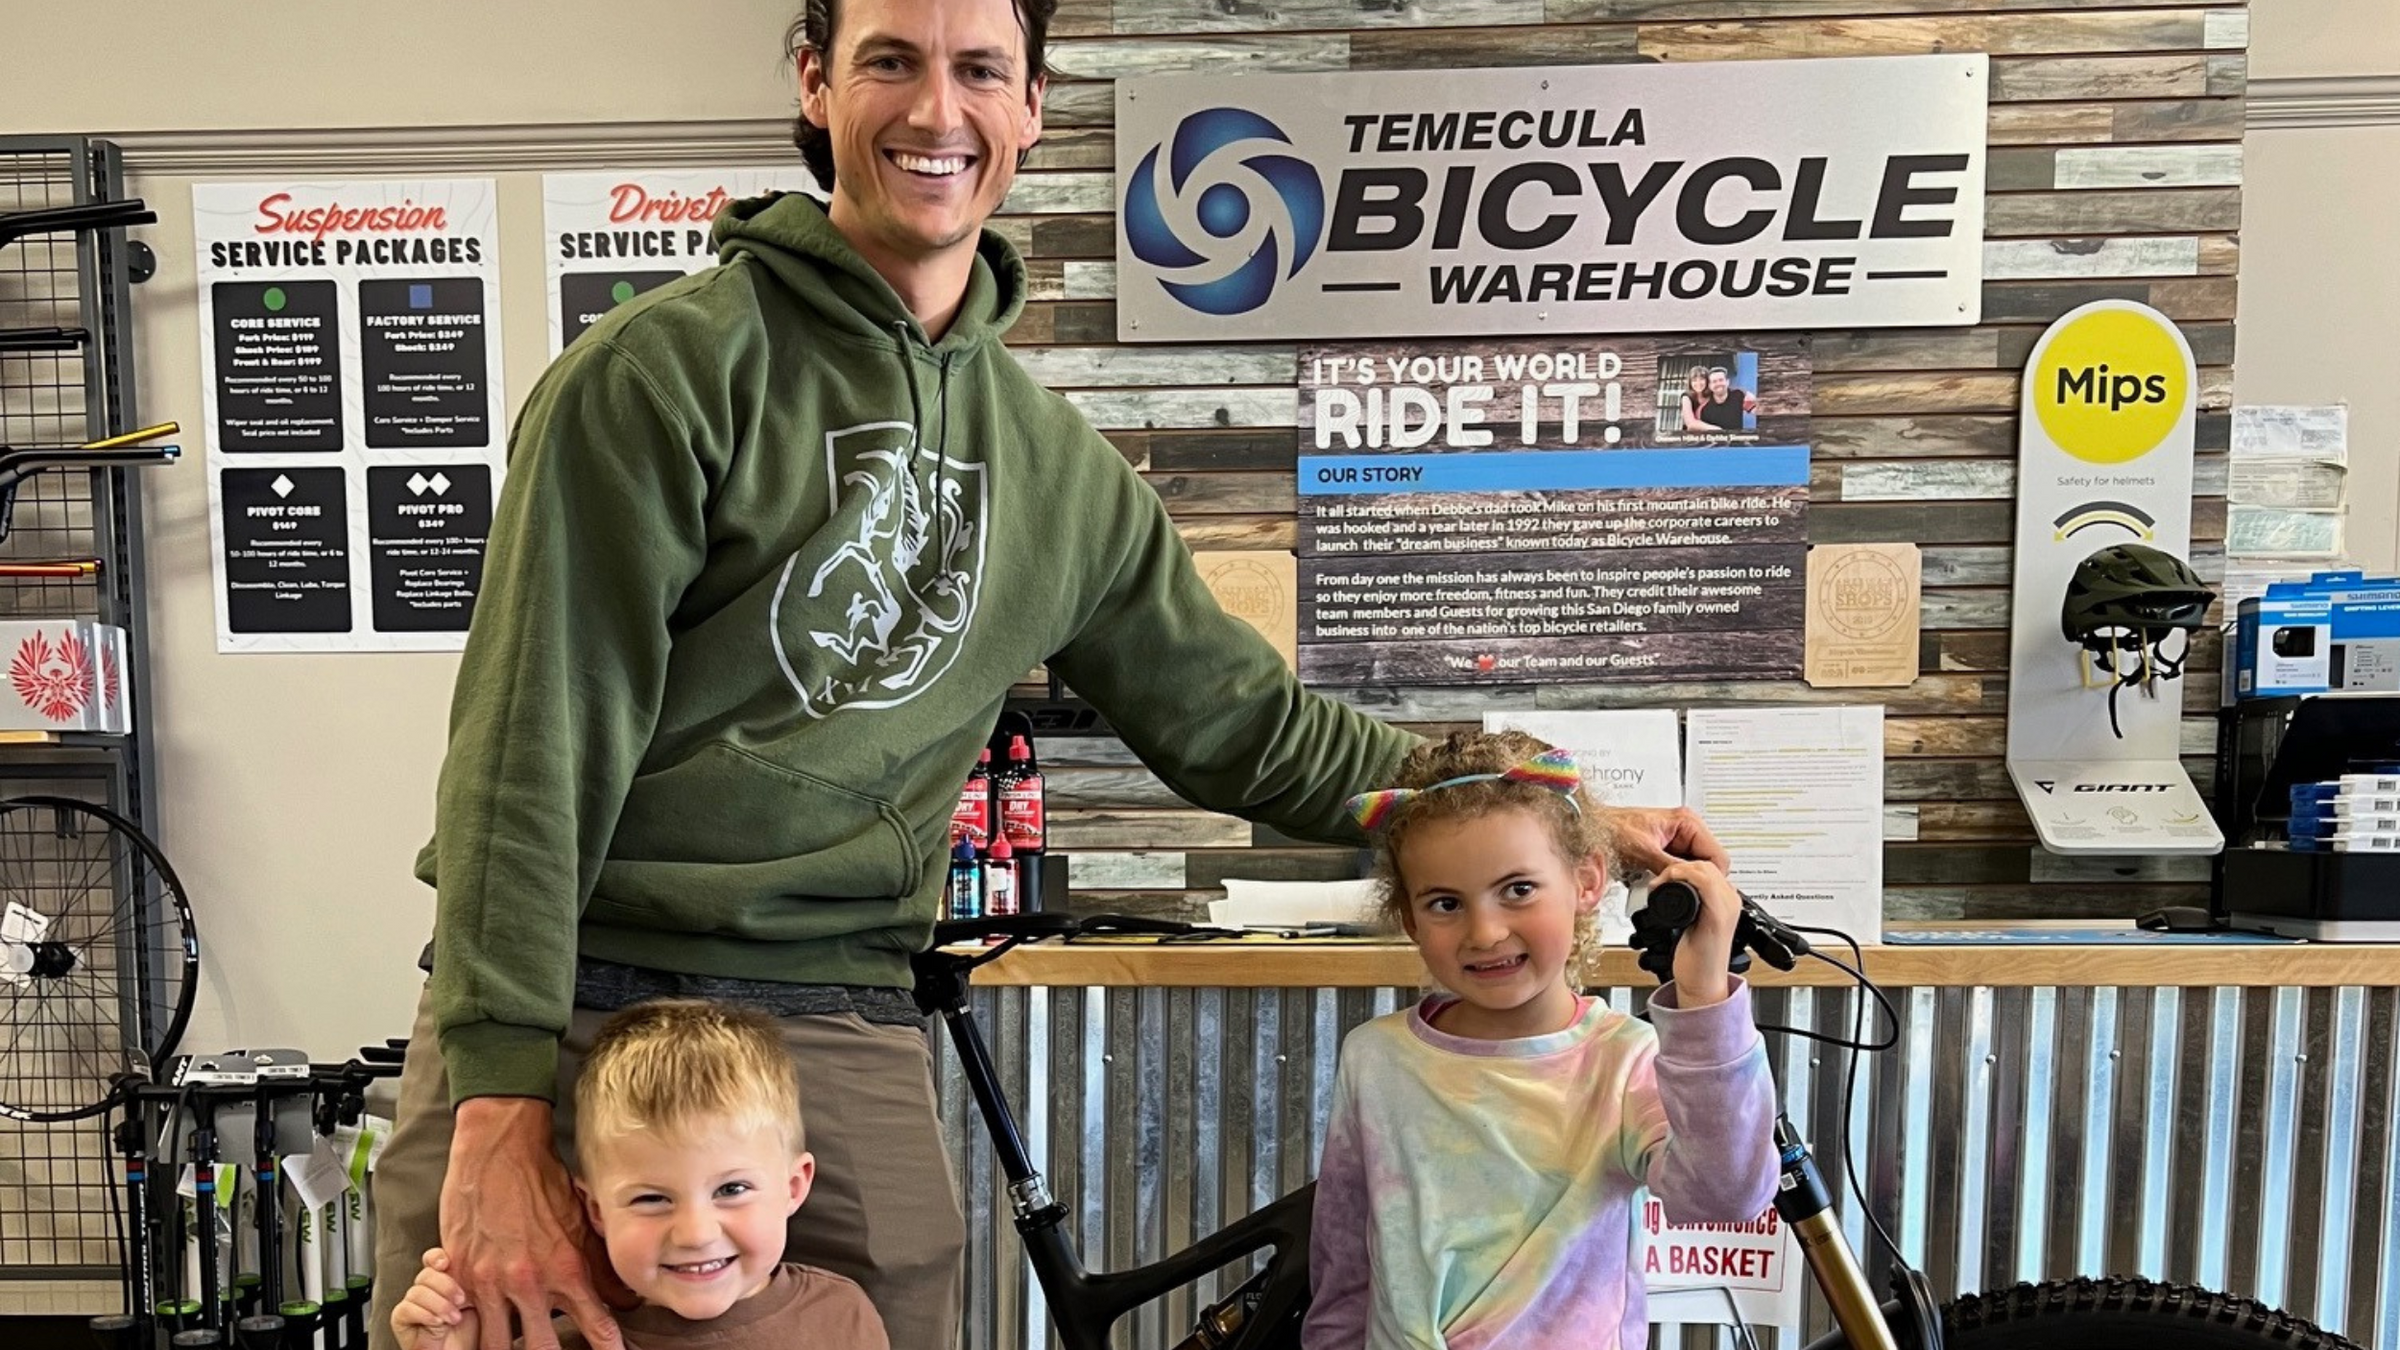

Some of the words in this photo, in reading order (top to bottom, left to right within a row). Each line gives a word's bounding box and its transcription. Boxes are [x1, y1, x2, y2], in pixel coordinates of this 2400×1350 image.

[1342, 108, 1647, 153] TEMECULA
[1326, 152, 1970, 253] BICYCLE
[254, 193, 448, 243] Suspension
[211, 240, 327, 268] SERVICE
[336, 237, 481, 265] PACKAGES
[560, 231, 675, 258] SERVICE
[1429, 256, 1856, 305] WAREHOUSE
[231, 318, 265, 329] CORE
[267, 317, 321, 328] SERVICE
[367, 316, 424, 326] FACTORY
[427, 314, 481, 325] SERVICE
[1314, 357, 1376, 385] IT'S
[1386, 355, 1484, 384] YOUR
[1494, 352, 1622, 381] WORLD
[2057, 364, 2166, 411] Mips
[1315, 385, 1494, 449] RIDE
[1521, 382, 1621, 445] IT!
[1318, 468, 1357, 483] OUR
[1362, 466, 1423, 482] STORY
[2057, 476, 2091, 488] Safety
[2094, 476, 2109, 485] for
[2113, 476, 2155, 486] helmets
[247, 506, 285, 517] PIVOT
[287, 506, 321, 516] CORE
[398, 504, 436, 515] PIVOT
[438, 503, 464, 515] PRO
[1316, 505, 1326, 517] It
[1329, 505, 1344, 517] all
[1346, 504, 1394, 517] started
[1395, 504, 1429, 516] when
[1485, 502, 1510, 514] dad
[1512, 502, 1540, 513] took
[1543, 501, 1575, 513] Mike
[1578, 502, 1594, 512] on
[1597, 500, 1615, 512] his
[1618, 499, 1644, 512] first
[1647, 499, 1708, 511] mountain
[1711, 498, 1738, 510] bike
[1741, 497, 1769, 509] ride.
[1773, 497, 1791, 509] He
[1316, 524, 1341, 534] was
[1343, 522, 1390, 534] hooked
[1392, 521, 1416, 534] and
[1418, 523, 1427, 533] a
[1428, 522, 1456, 534] year
[1459, 519, 1489, 532] later
[1492, 520, 1504, 531] in
[1507, 519, 1540, 531] 1992
[1542, 519, 1571, 532] they
[1573, 520, 1603, 532] gave
[1605, 519, 1622, 531] up
[1623, 517, 1646, 529] the
[1649, 517, 1711, 529] corporate
[1714, 516, 1762, 527] careers
[1765, 515, 1779, 526] to
[1316, 539, 1358, 552] launch
[1363, 538, 1393, 551] their
[1395, 538, 1441, 550] "dream
[1444, 536, 1504, 550] business"
[1506, 536, 1549, 549] known
[1552, 535, 1588, 549] today
[1591, 537, 1604, 548] as
[1607, 533, 1653, 548] Bicycle
[1655, 532, 1733, 546] Warehouse.
[1316, 574, 1349, 586] From
[1351, 573, 1374, 587] day
[1376, 575, 1400, 585] one
[1402, 573, 1423, 584] the
[1426, 572, 1474, 584] mission
[1476, 571, 1498, 583] has
[1500, 570, 1544, 584] always
[1546, 569, 1578, 582] been
[1581, 570, 1594, 581] to
[1597, 568, 1641, 583] inspire
[1643, 567, 1695, 582] people's
[1698, 566, 1746, 581] passion
[1749, 566, 1763, 578] to
[1765, 565, 1791, 578] ride
[1316, 593, 1331, 603] so
[1333, 590, 1361, 604] they
[1363, 590, 1398, 604] enjoy
[1400, 592, 1433, 602] more
[1436, 588, 1492, 602] freedom,
[1495, 587, 1537, 600] fitness
[1539, 587, 1563, 599] and
[1566, 586, 1590, 599] fun.
[1592, 586, 1625, 600] They
[1626, 584, 1664, 597] credit
[1667, 584, 1698, 597] their
[1700, 585, 1762, 596] awesome
[2347, 592, 2400, 601] SHIMANO
[1316, 608, 1348, 620] team
[1353, 606, 1412, 620] members
[1414, 606, 1437, 618] and
[1440, 606, 1484, 618] Guests
[1485, 605, 1503, 617] for
[1506, 604, 1559, 619] growing
[1561, 604, 1585, 616] this
[1587, 603, 1610, 615] San
[1613, 602, 1651, 616] Diego
[1653, 601, 1694, 615] family
[1696, 601, 1740, 613] owned
[1316, 624, 1369, 637] business
[1372, 624, 1397, 636] into
[1402, 626, 1425, 636] one
[1428, 622, 1442, 635] of
[1443, 623, 1464, 635] the
[1467, 622, 1516, 635] nation's
[1519, 623, 1541, 635] top
[1543, 621, 1587, 635] bicycle
[1590, 620, 1647, 633] retailers.
[1500, 655, 1520, 668] our
[1523, 655, 1557, 668] Team
[1560, 654, 1583, 667] and
[1585, 655, 1608, 667] our
[1583, 765, 1645, 784] chrony
[2074, 784, 2176, 793] GIANT
[1796, 893, 1834, 901] Questions
[1645, 1245, 1661, 1274] A
[1670, 1246, 1775, 1278] BASKET
